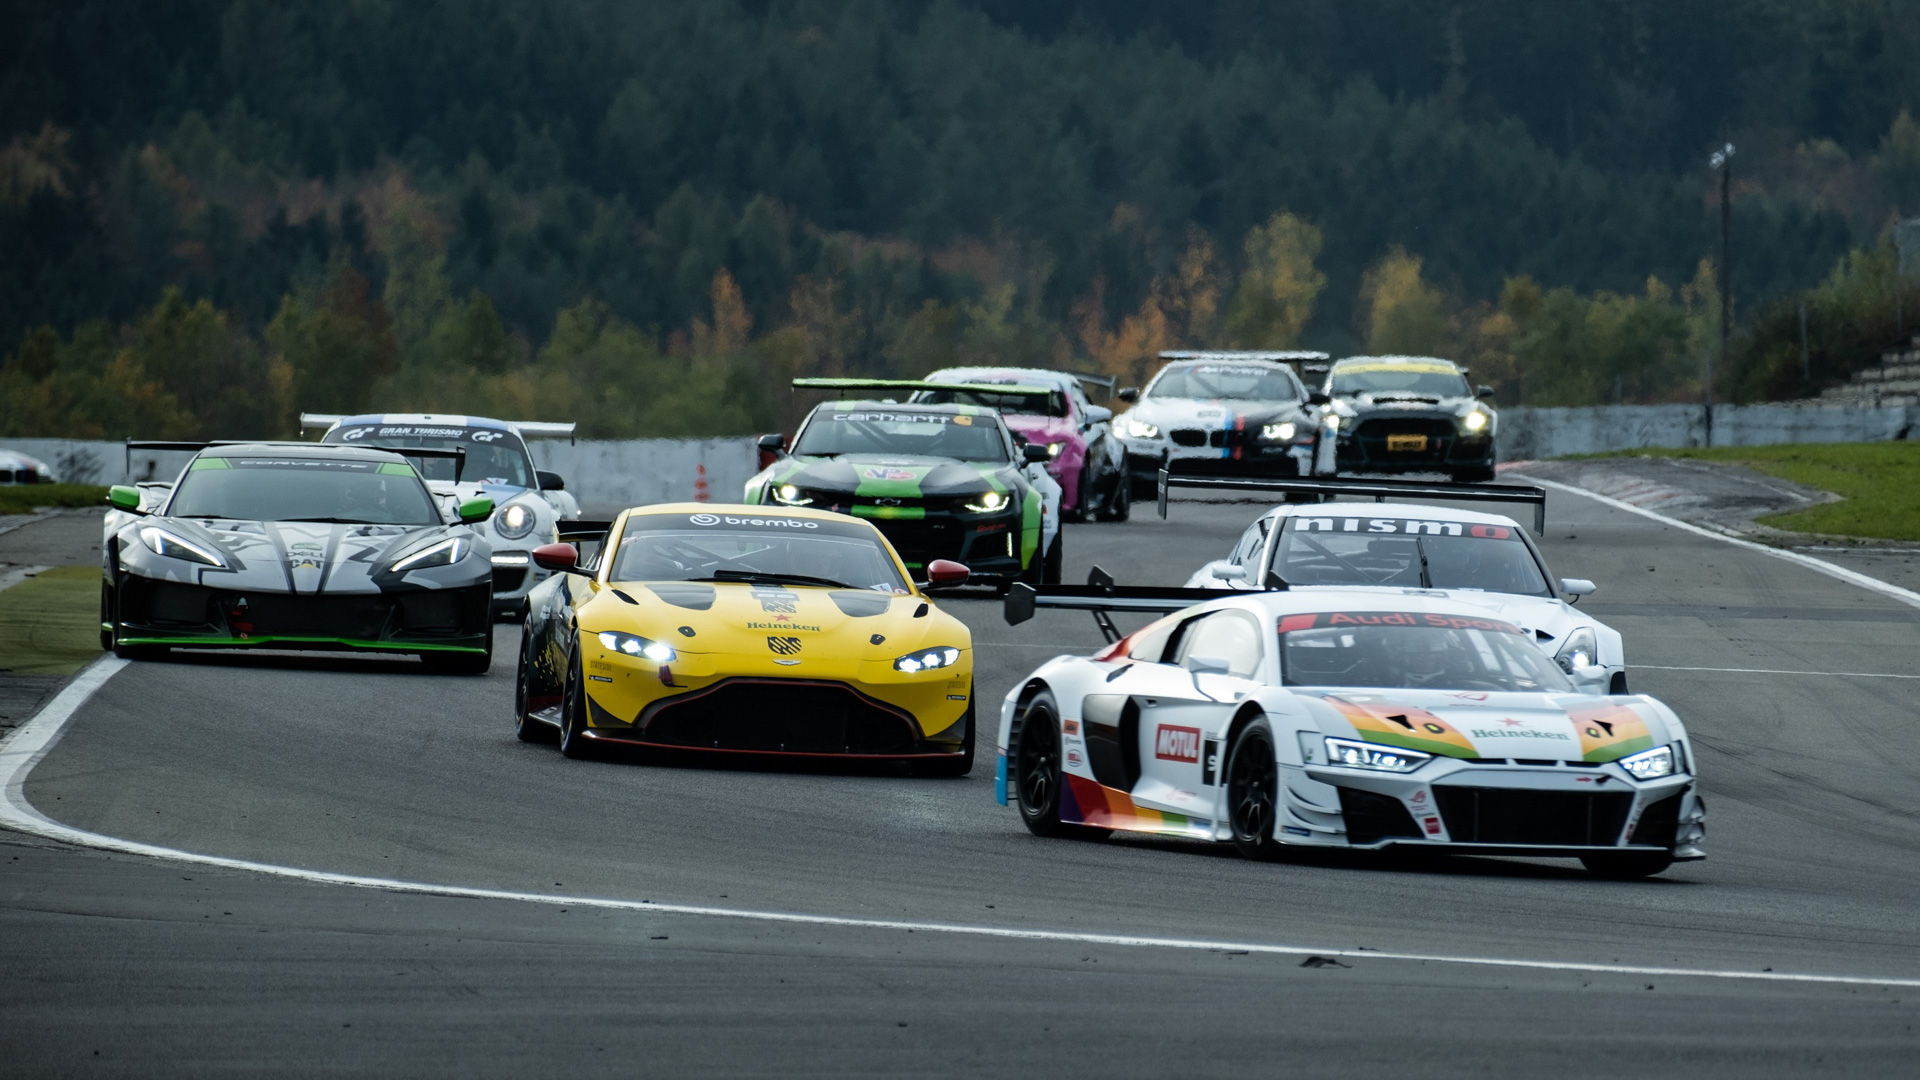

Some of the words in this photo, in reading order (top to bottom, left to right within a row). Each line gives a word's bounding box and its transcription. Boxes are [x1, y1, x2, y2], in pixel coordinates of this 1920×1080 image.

[833, 413, 950, 424] carhartt
[379, 427, 411, 435] GRAN
[414, 428, 464, 436] TURISMO
[725, 516, 818, 529] brembo
[1295, 518, 1510, 540] nismo
[288, 559, 324, 569] CAT
[1330, 612, 1417, 625] Audi
[747, 622, 821, 632] Heineken
[1471, 729, 1570, 740] Heineken
[1158, 729, 1199, 758] MOTUL
